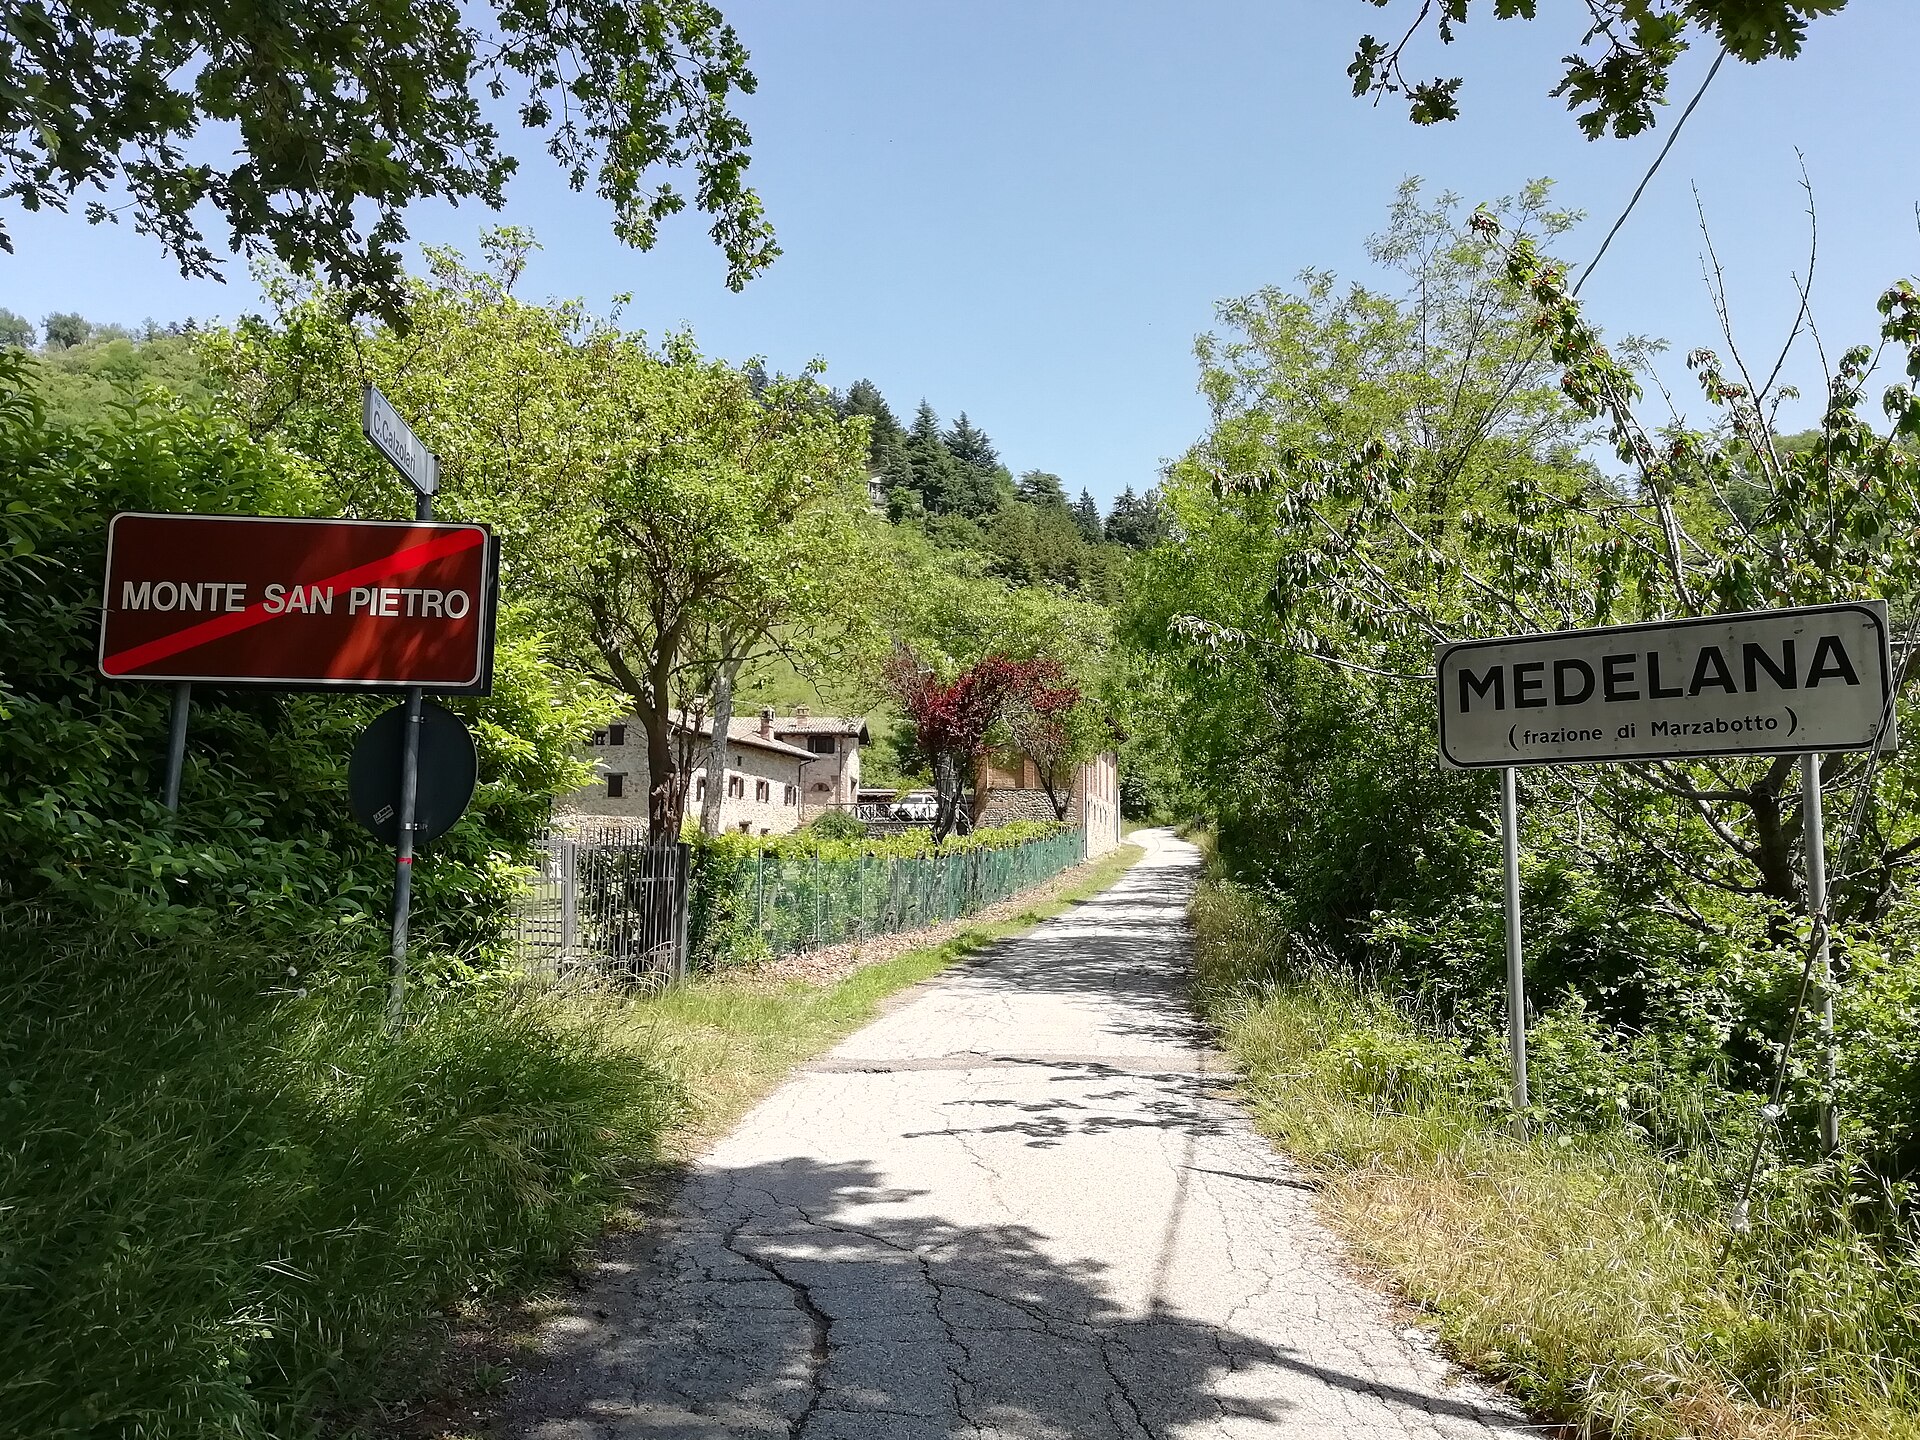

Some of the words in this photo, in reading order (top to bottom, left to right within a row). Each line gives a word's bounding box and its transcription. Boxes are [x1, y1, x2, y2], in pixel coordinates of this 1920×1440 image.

[121, 581, 247, 612] MONTE
[262, 583, 334, 615] SAN
[349, 587, 470, 619] PIETRO
[1458, 635, 1861, 714] MEDELANA
[1508, 723, 1603, 752] (frazione
[1617, 722, 1636, 740] di
[1650, 705, 1799, 738] Marzabotto)
